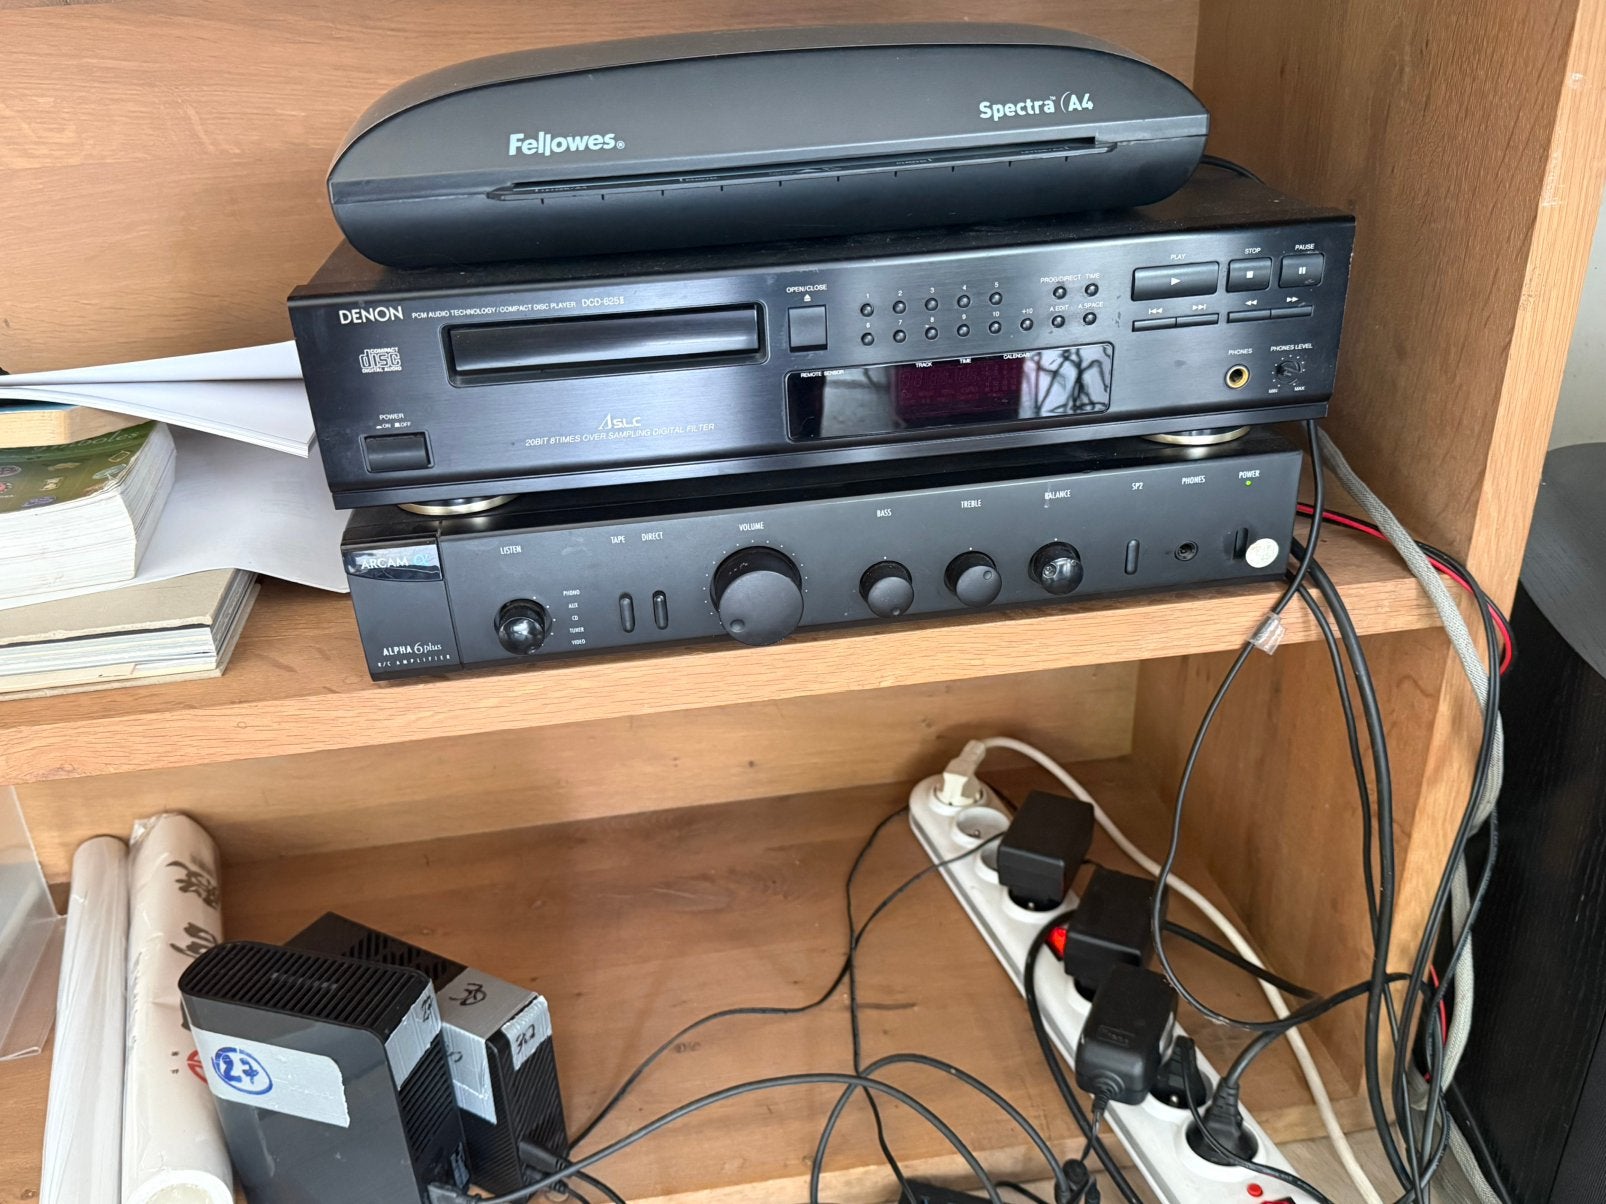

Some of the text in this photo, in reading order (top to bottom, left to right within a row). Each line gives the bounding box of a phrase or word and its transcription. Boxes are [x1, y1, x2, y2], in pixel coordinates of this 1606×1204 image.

[1244, 247, 1261, 255] STOP
[1294, 243, 1315, 251] PAUSE
[1085, 272, 1101, 280] TIME
[785, 284, 828, 293] OPEN/CLOSE
[428, 310, 449, 318] AUDIO
[450, 306, 496, 317] TECHNOLOGY
[500, 304, 532, 312] COMPACT
[533, 302, 549, 310] DISC
[550, 301, 576, 309] PLAYER
[339, 306, 404, 325] DENON
[1270, 344, 1294, 352] PHONES
[525, 437, 548, 447] 20BIT
[549, 435, 581, 445] 8TIMES
[652, 426, 685, 435] DIGITAL
[686, 423, 715, 432] FILTER
[1238, 470, 1260, 479] POWER
[1181, 475, 1206, 485] PHONES
[1131, 482, 1144, 490] SP2
[1044, 489, 1071, 500] BALANCE
[960, 499, 982, 508] TREBLE
[876, 509, 892, 517] BASS
[738, 521, 765, 531] VOLUME
[641, 532, 663, 541] DIRECT
[500, 545, 521, 554] LISTEN
[361, 556, 409, 570] ARCAM
[383, 642, 442, 656] ALPHA 6 plus
